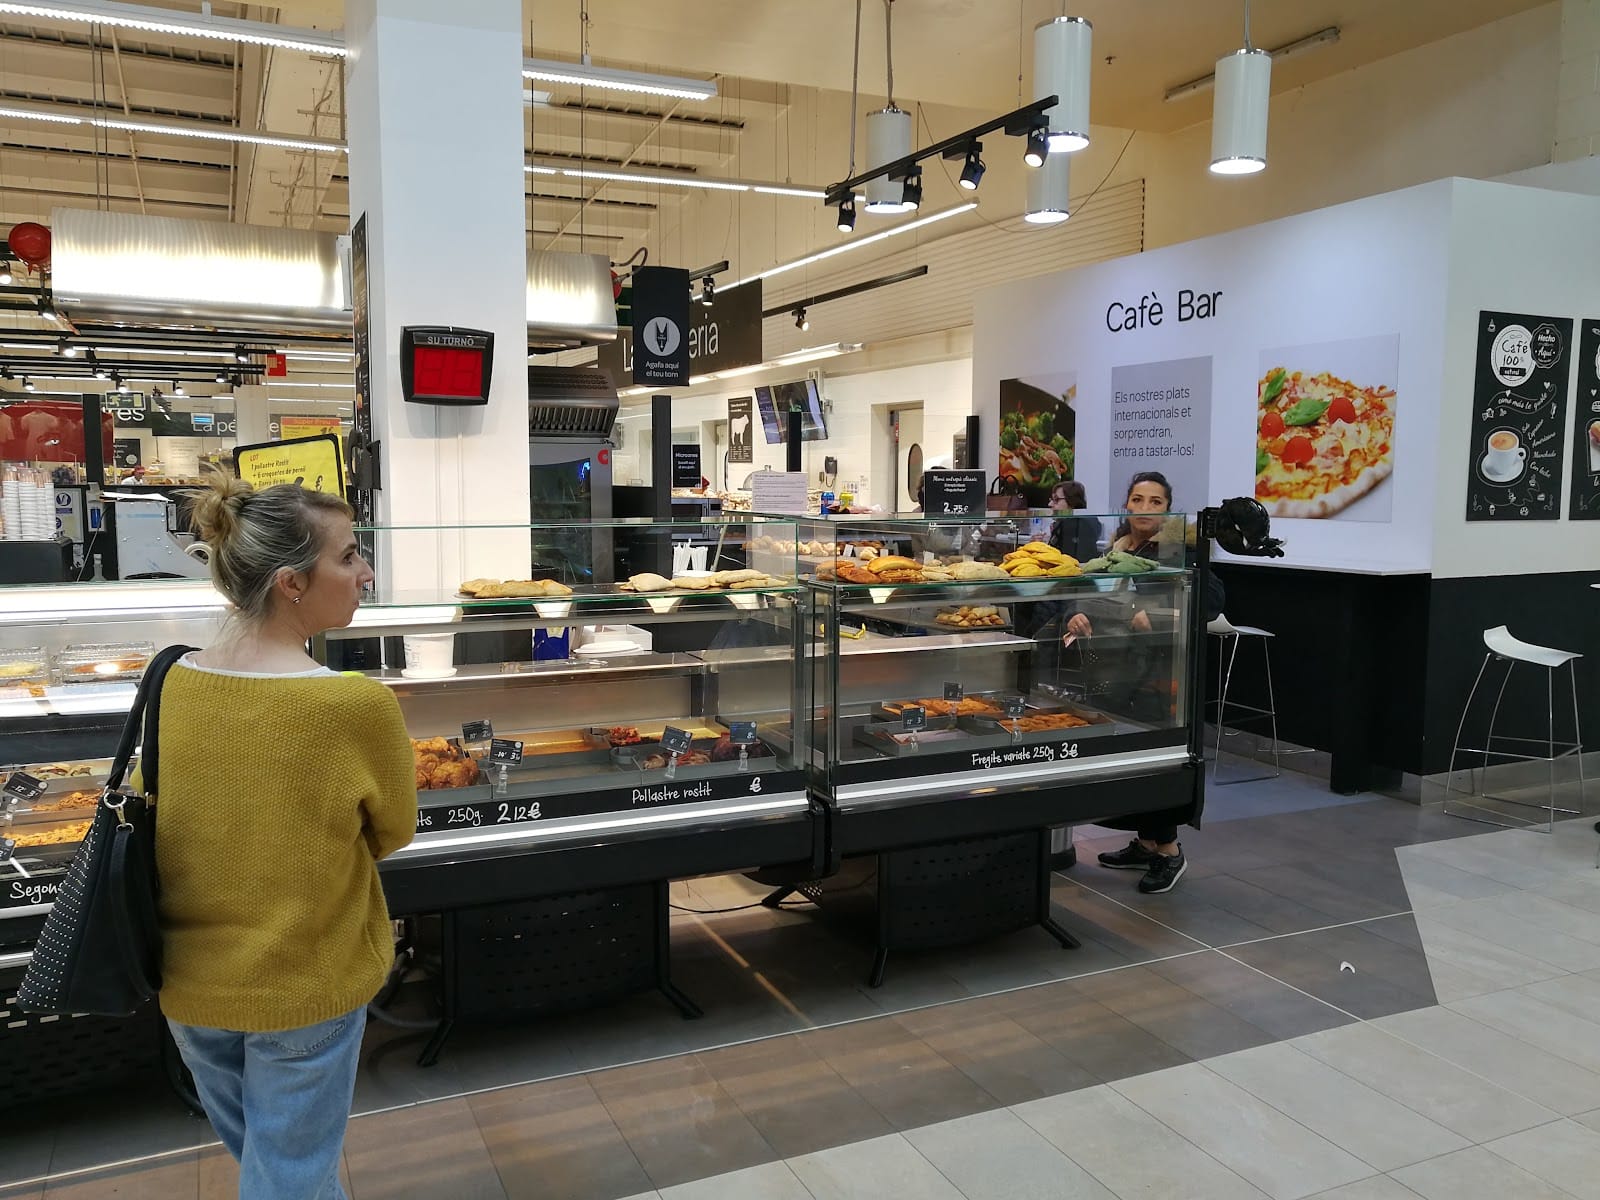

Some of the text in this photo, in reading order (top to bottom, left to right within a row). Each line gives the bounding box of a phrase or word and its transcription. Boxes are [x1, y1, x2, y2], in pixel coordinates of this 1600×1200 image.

[1106, 289, 1222, 332] Cafè Bar
[427, 336, 474, 346] SU TURNO
[689, 313, 719, 358] eria
[1502, 340, 1528, 354] Café
[1503, 355, 1523, 366] 100
[1115, 386, 1190, 403] Els nostres plats
[1114, 406, 1192, 421] internacionals et
[1114, 426, 1173, 441] sorprendran,
[1113, 443, 1195, 457] entra a tastar-los!
[971, 742, 1079, 769] Fregits variats 250g 3€
[632, 777, 762, 804] Pollastre rostit €
[416, 810, 433, 827] its
[448, 806, 484, 826] 250g.
